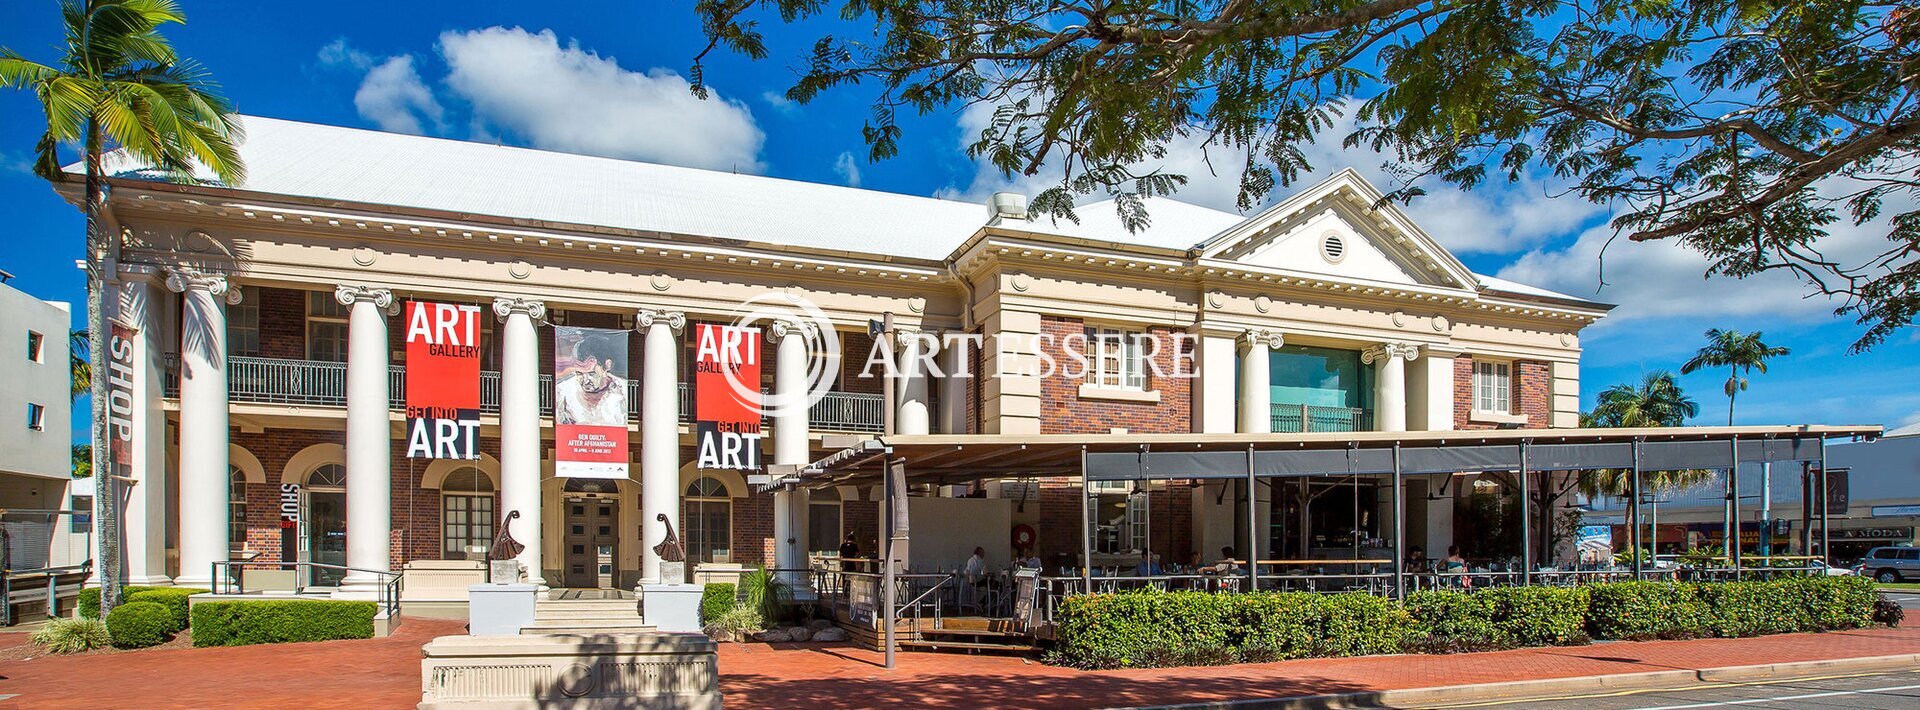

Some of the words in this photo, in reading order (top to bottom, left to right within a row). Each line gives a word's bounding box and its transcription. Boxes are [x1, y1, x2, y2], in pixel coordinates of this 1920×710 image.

[407, 302, 481, 346] ART
[430, 343, 480, 358] GALLERY
[697, 324, 761, 365] ART
[697, 361, 741, 375] GALLERY
[110, 335, 133, 442] SHOP
[406, 406, 428, 419] GET
[431, 406, 457, 420] INTO
[717, 421, 735, 433] GET
[739, 421, 761, 434] INTO
[406, 418, 481, 460] ART
[697, 431, 761, 470] ART
